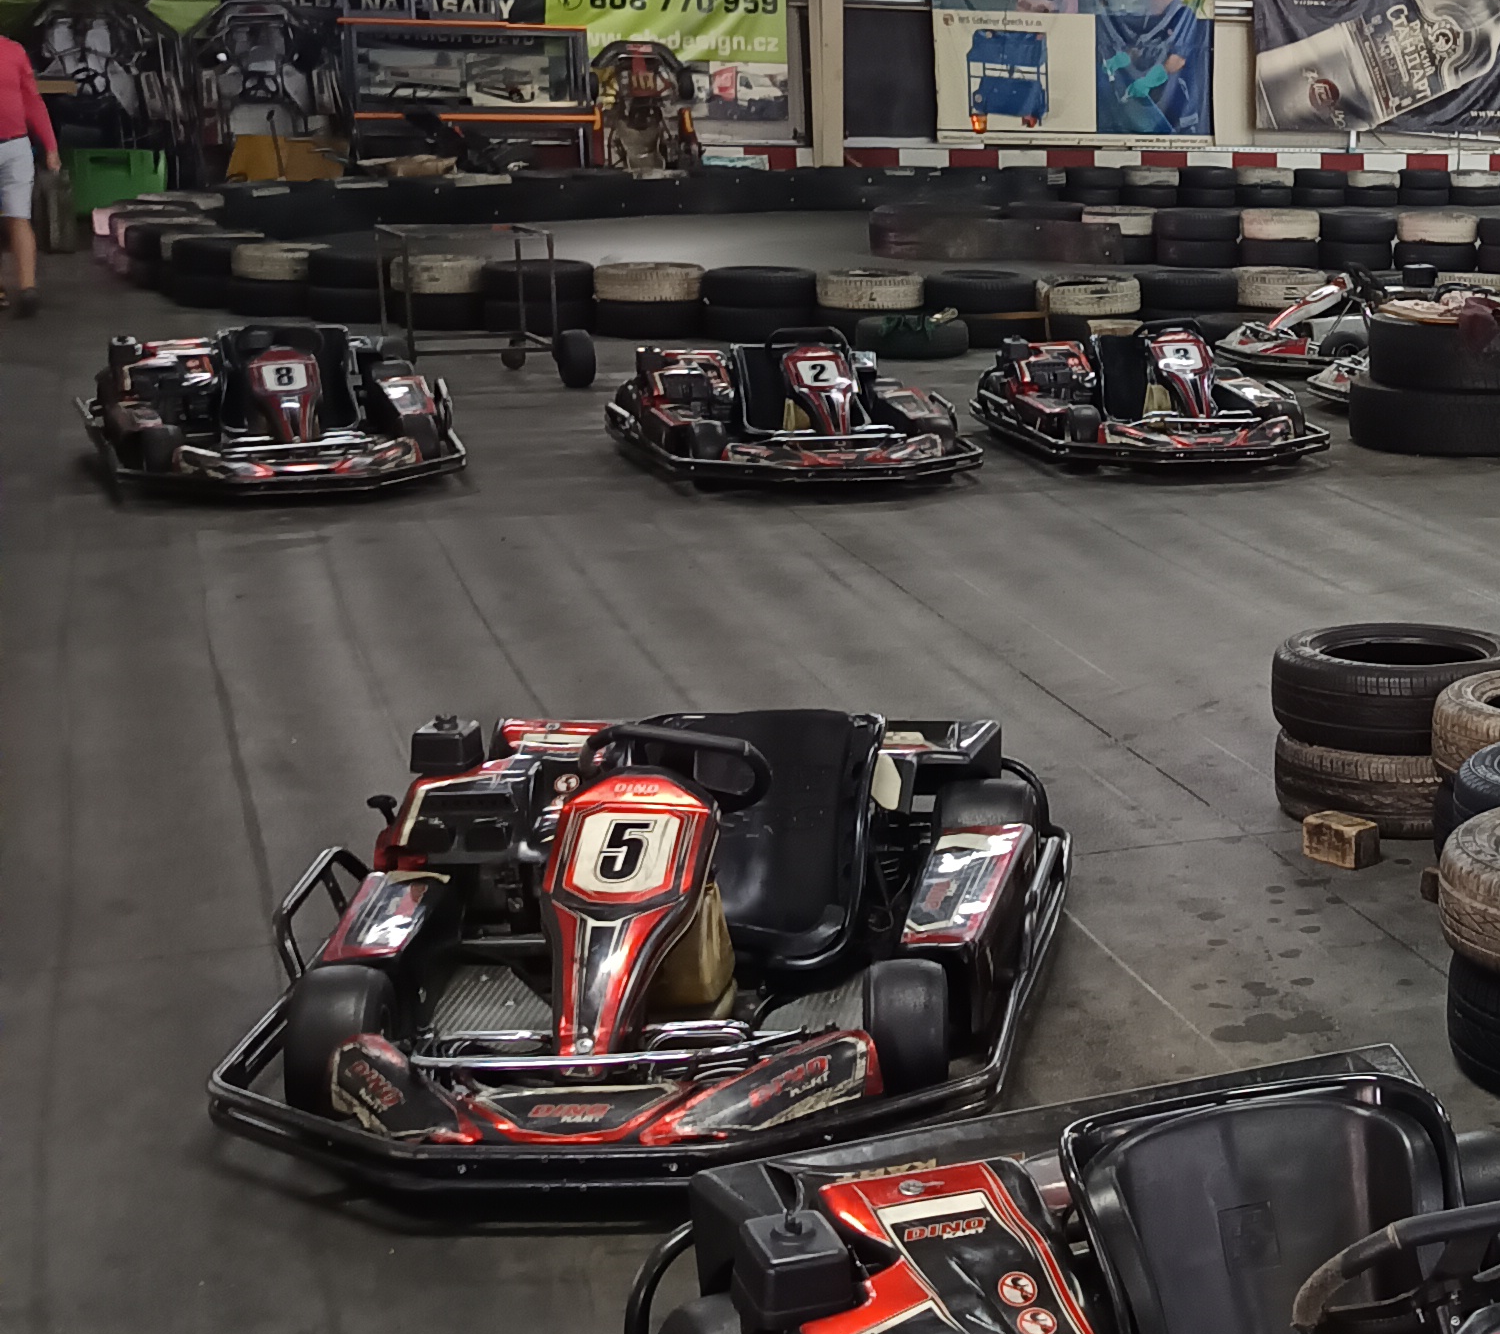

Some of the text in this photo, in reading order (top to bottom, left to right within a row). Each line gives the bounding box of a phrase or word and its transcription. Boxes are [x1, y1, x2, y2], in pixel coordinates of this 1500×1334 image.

[273, 365, 296, 387] 8
[810, 363, 829, 383] 2
[613, 782, 660, 794] DINO
[594, 819, 657, 884] 5
[904, 1216, 987, 1242] DINO
